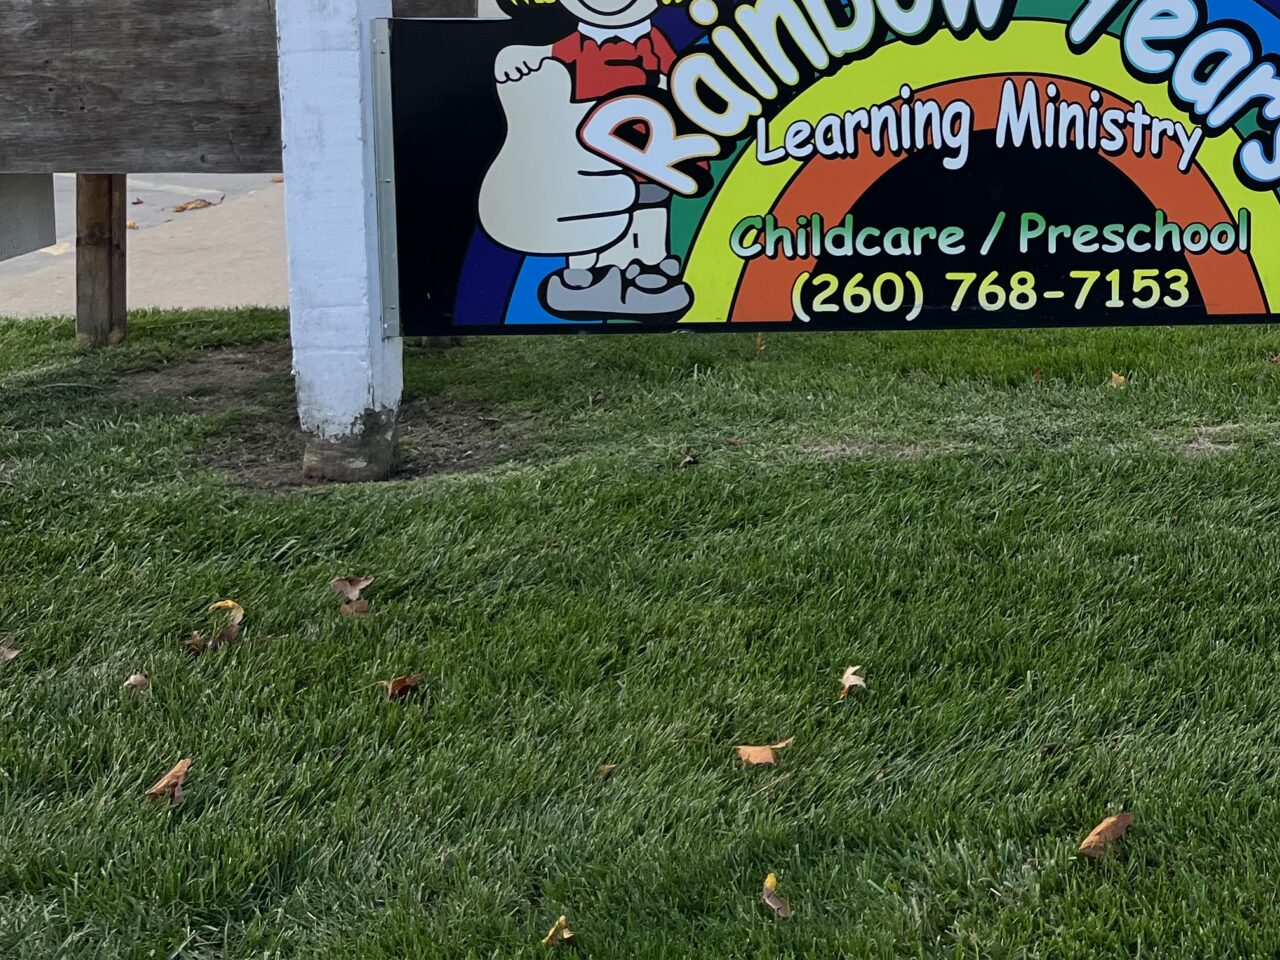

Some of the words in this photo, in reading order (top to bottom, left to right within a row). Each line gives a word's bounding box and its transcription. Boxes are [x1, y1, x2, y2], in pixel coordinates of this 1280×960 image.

[755, 86, 970, 170] Learning
[995, 79, 1203, 171] Ministry
[730, 214, 966, 257] Childcare
[1019, 208, 1251, 254] Preschool
[791, 272, 924, 323] (260)
[944, 268, 1190, 312] 768-7153
